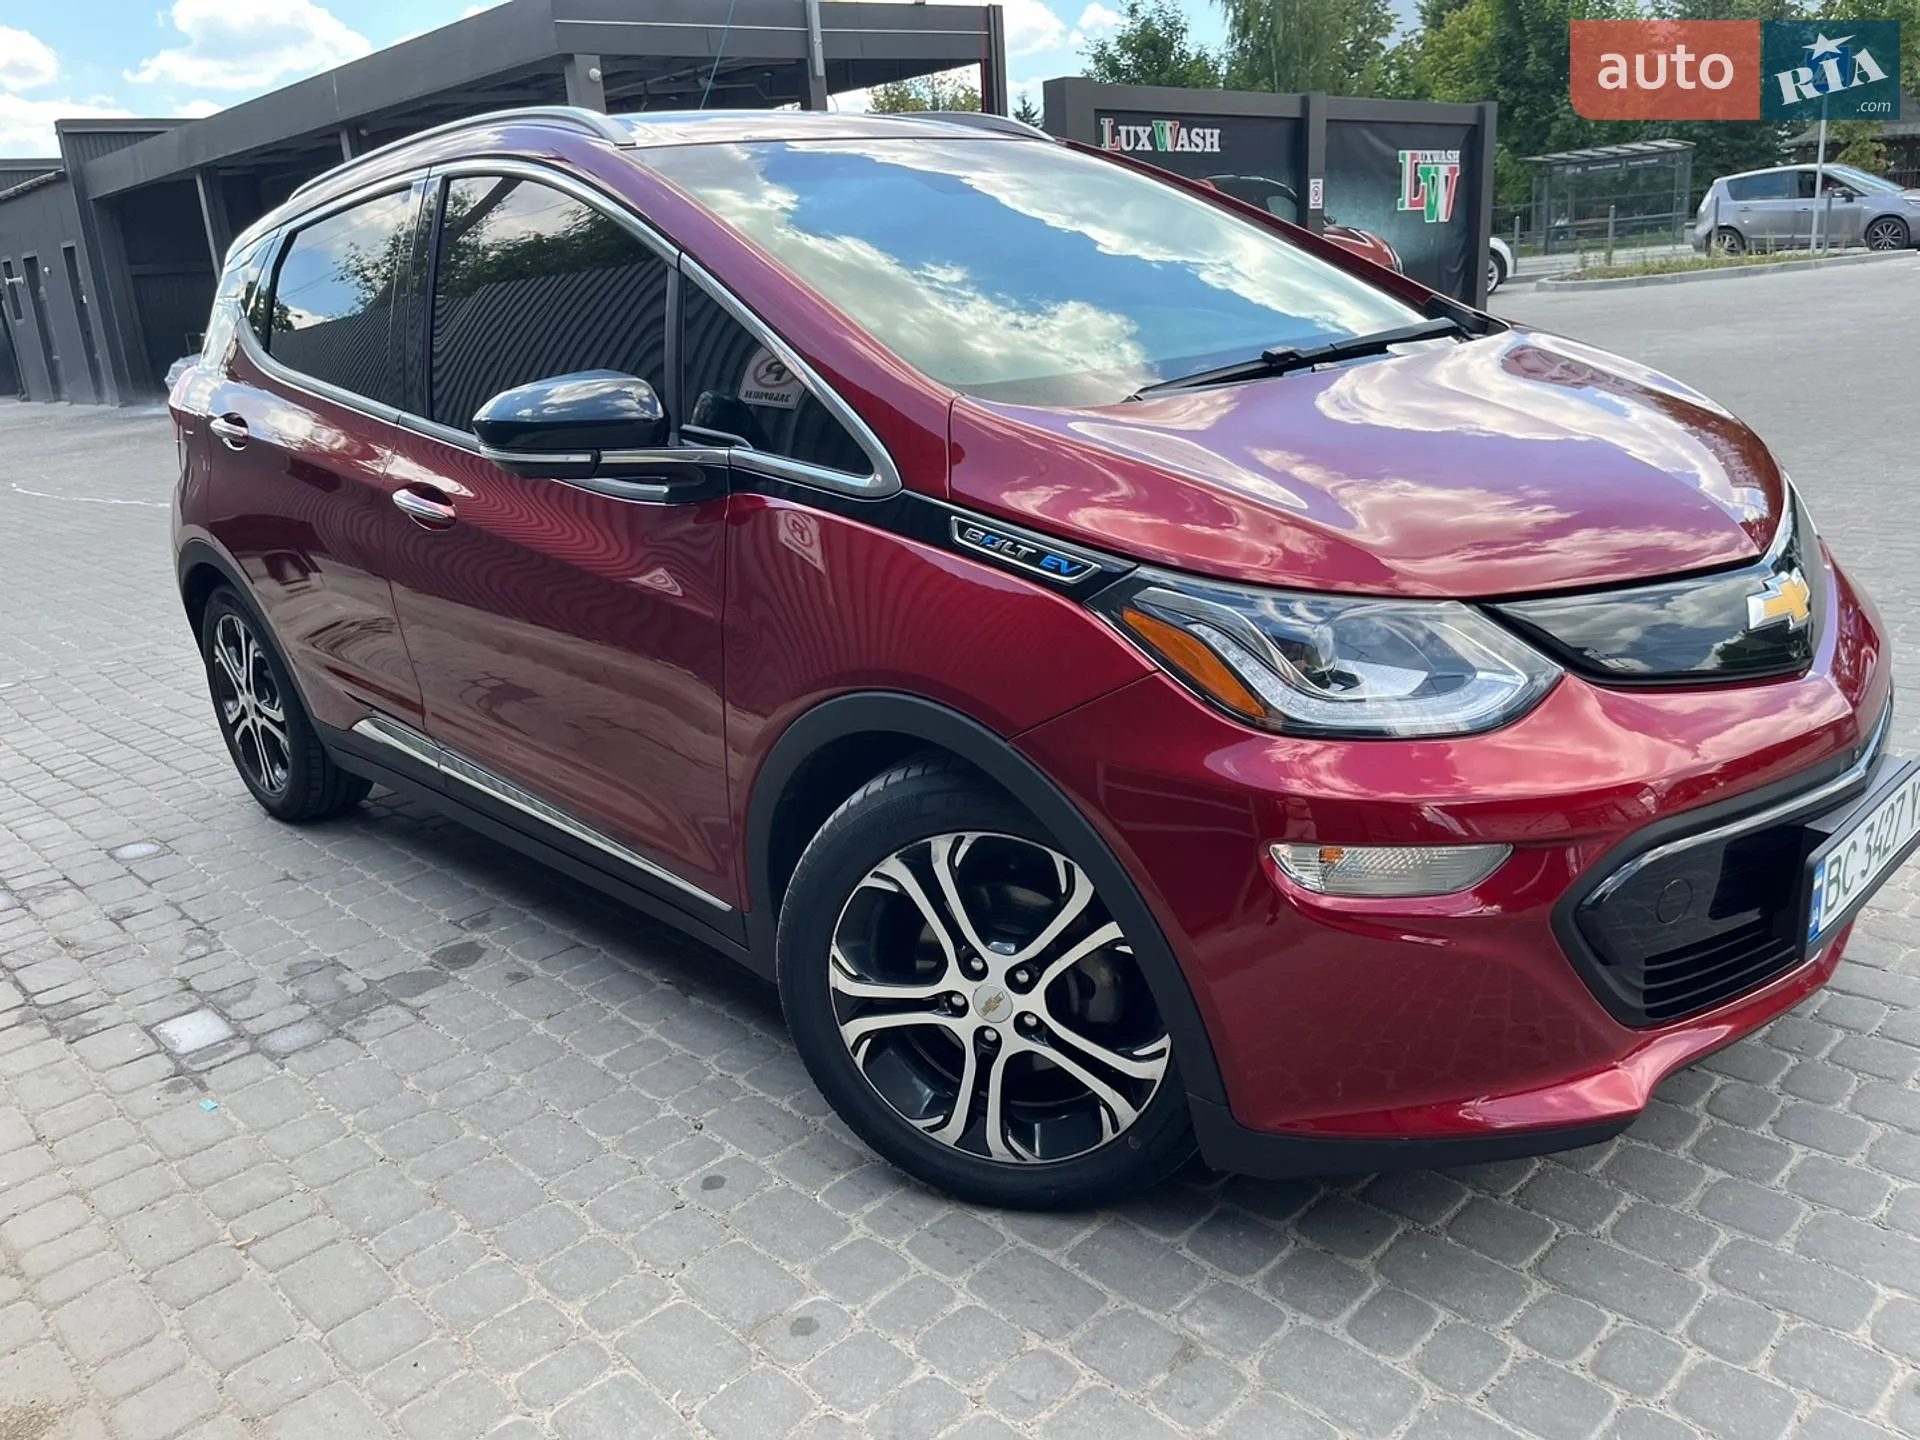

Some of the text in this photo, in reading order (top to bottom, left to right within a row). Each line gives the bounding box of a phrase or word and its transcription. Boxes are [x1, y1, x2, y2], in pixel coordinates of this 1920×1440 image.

[1039, 553, 1083, 576] EV
[1824, 839, 1857, 915] BC
[1861, 789, 1906, 878] 3427
